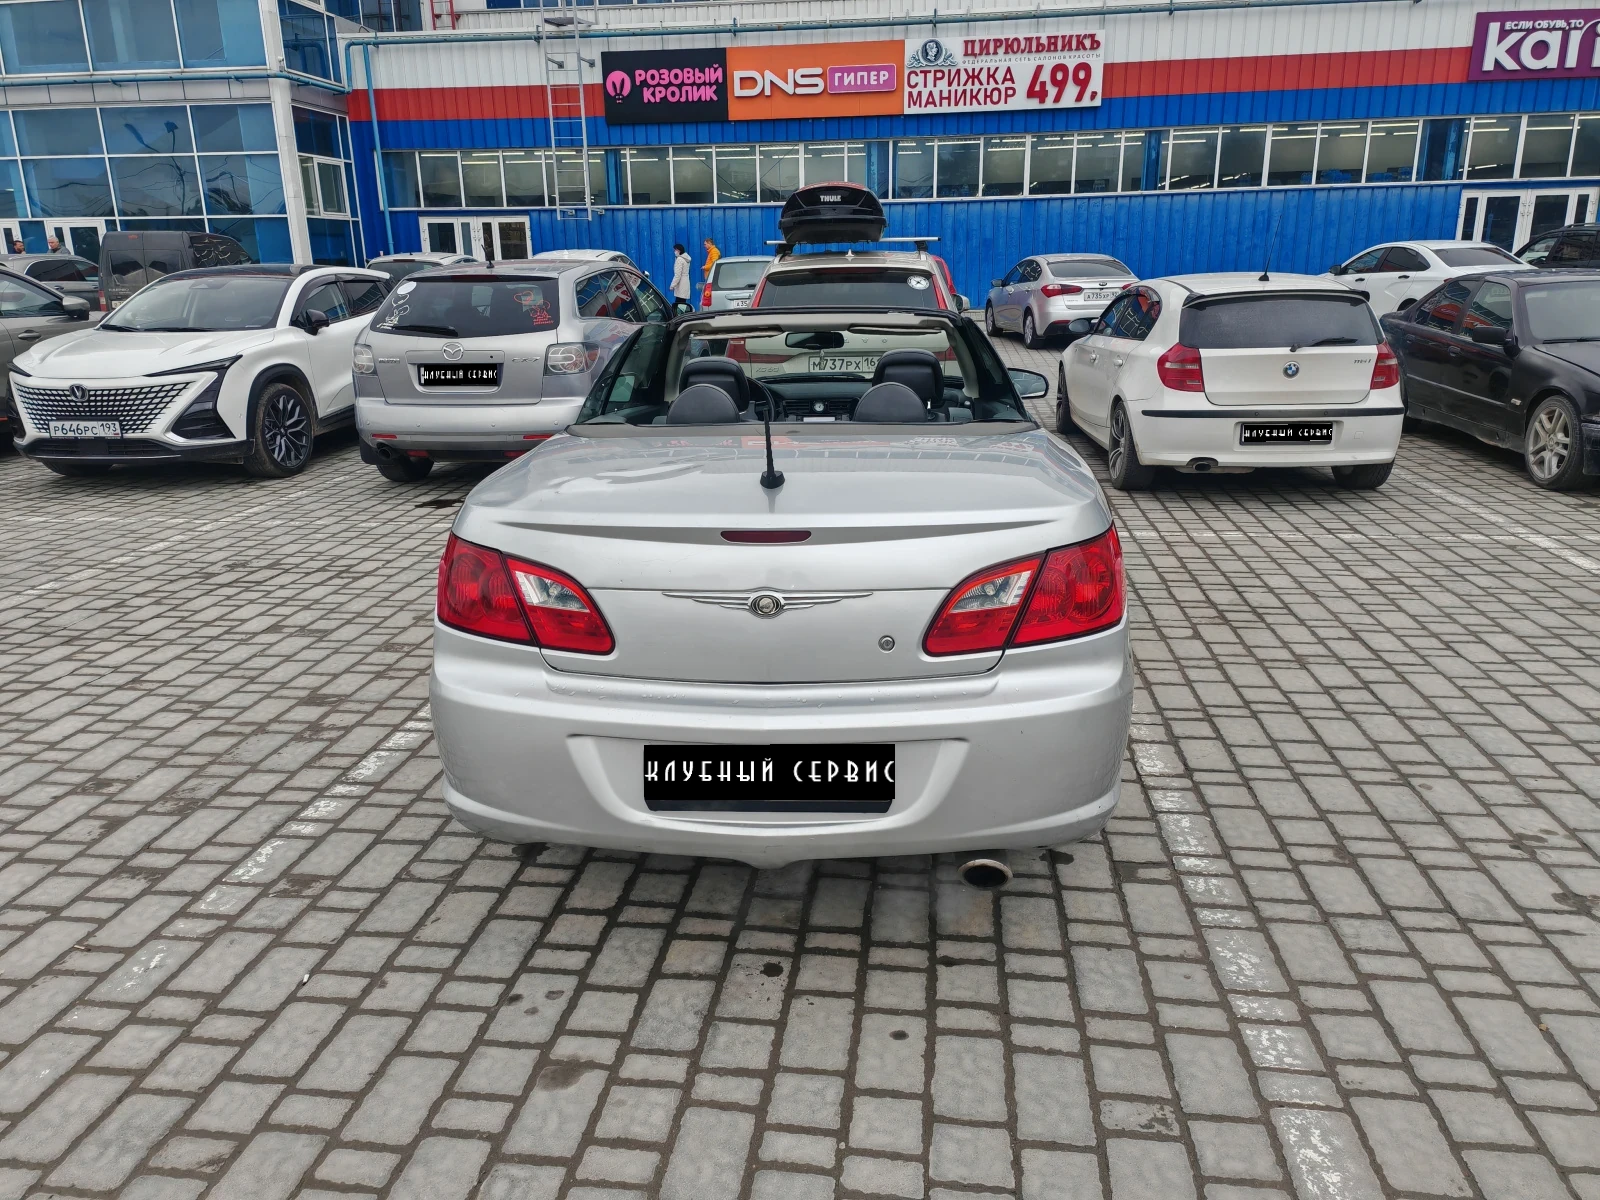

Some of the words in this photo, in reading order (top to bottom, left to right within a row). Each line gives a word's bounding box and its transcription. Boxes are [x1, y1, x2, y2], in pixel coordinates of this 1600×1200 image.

[1504, 20, 1533, 30] ЕСЛИ
[963, 33, 1101, 59] ЦИРЮЛЬНИКЪ
[1482, 19, 1600, 71] kari
[962, 57, 1012, 65] ФЕДЕРАЛЬНАЯ
[1033, 54, 1067, 62] САЛОНОВ
[634, 63, 723, 86] РОЗОВЫЙ
[733, 67, 825, 98] DNS
[834, 71, 889, 86] ГИПЕР
[906, 66, 1016, 89] СТРИЖКА
[642, 85, 718, 103] КРОЛИК
[907, 87, 1017, 108] МАНИКЮР
